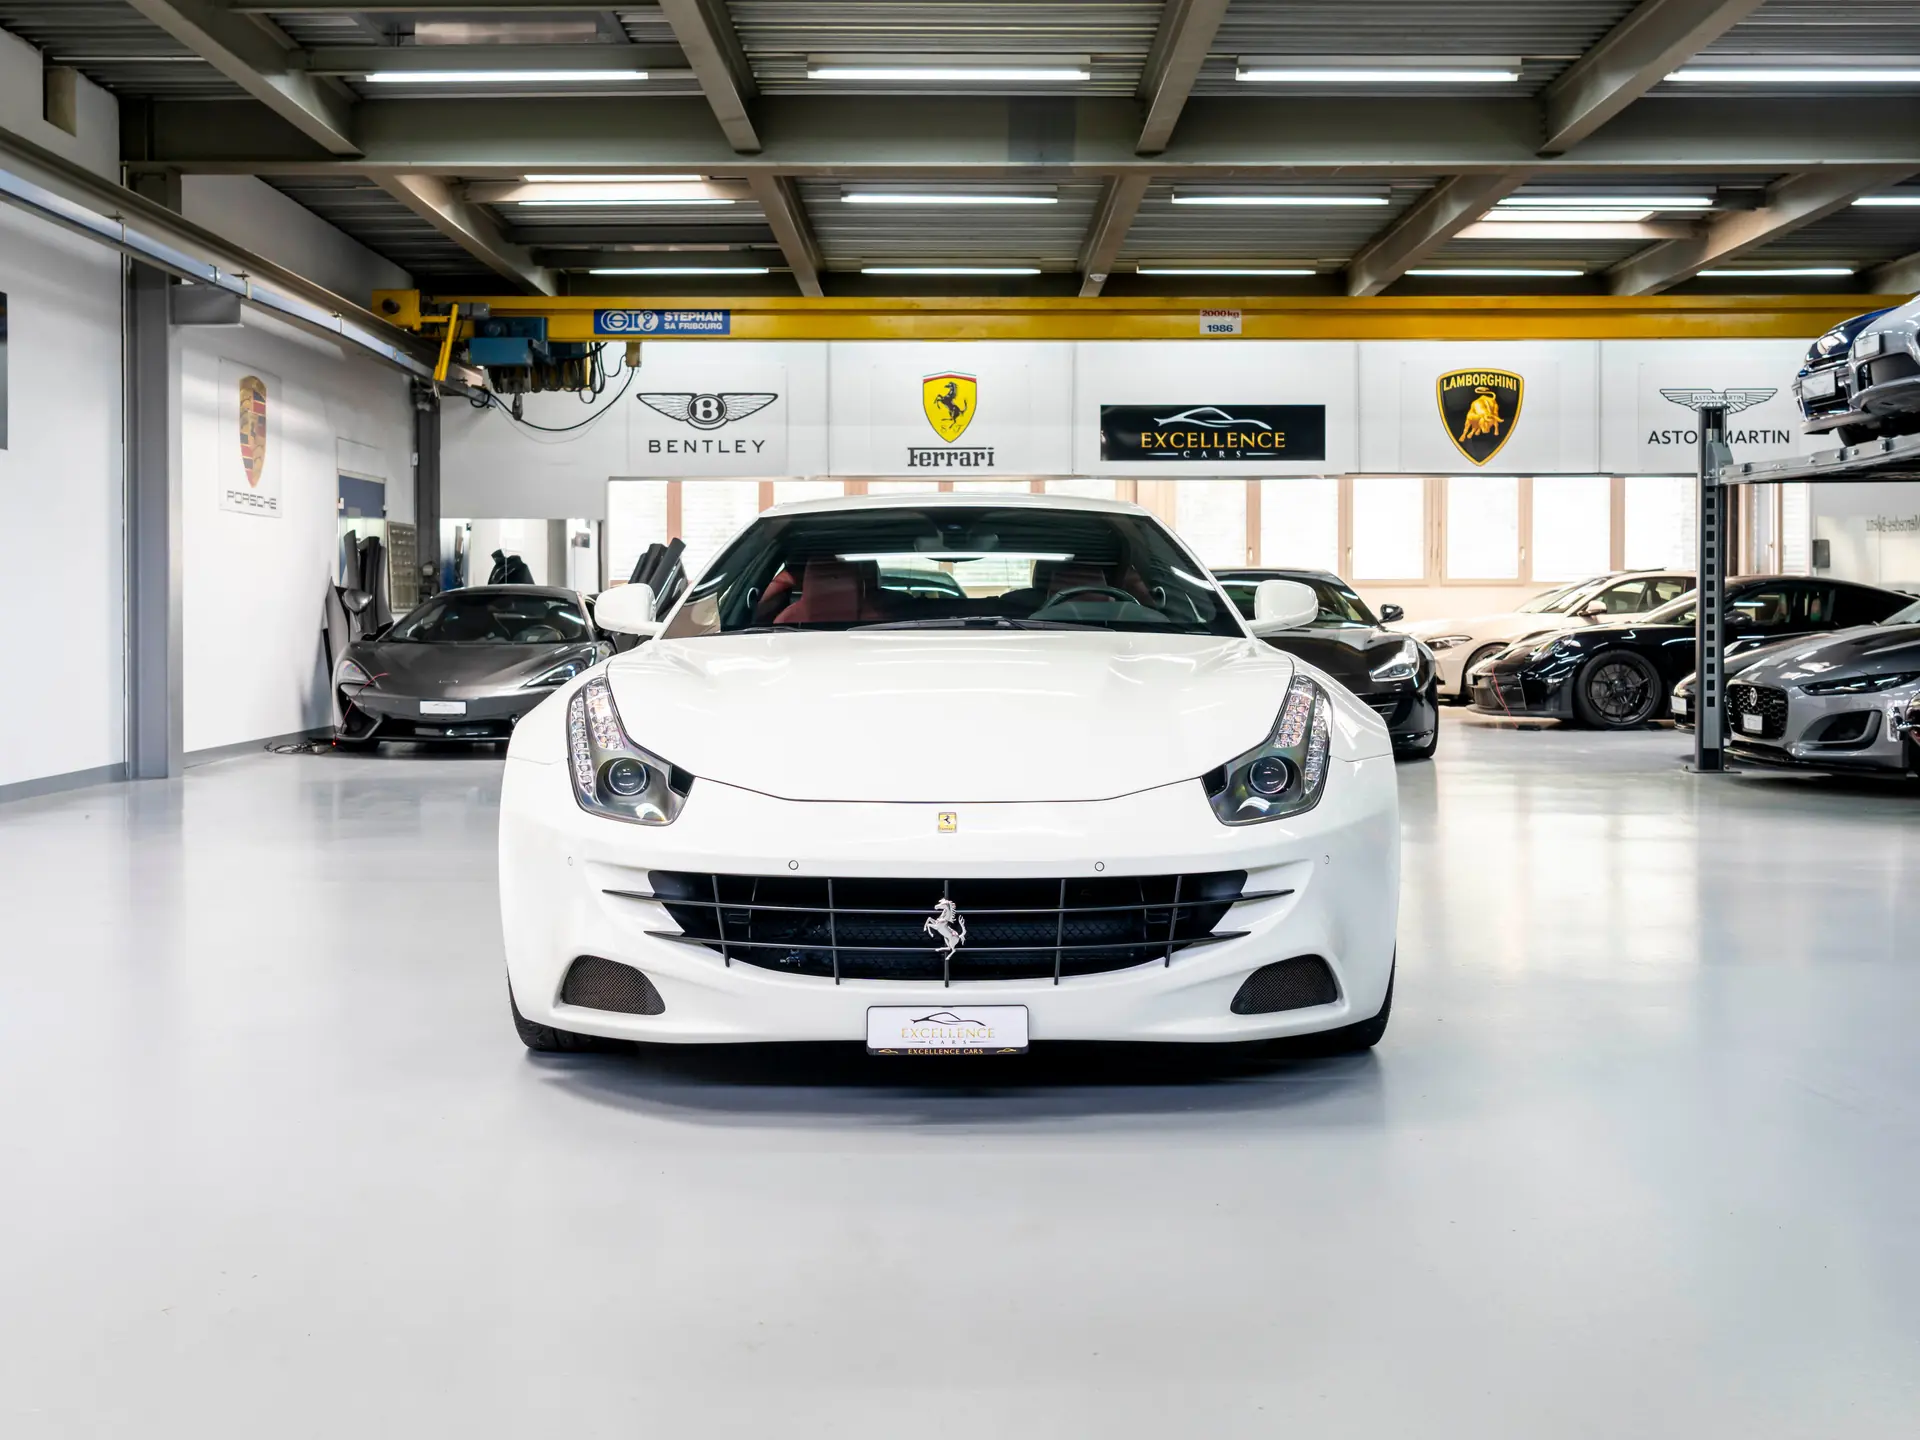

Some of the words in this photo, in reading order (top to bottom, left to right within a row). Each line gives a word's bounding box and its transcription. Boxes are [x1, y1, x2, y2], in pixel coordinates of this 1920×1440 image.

[664, 311, 723, 322] STEPHAN
[664, 322, 676, 330] SA
[678, 322, 723, 330] FRIBOURG
[1207, 324, 1234, 333] 1986
[1443, 373, 1517, 391] LAMBORGHINI
[1141, 432, 1286, 448] EXCELLENCE
[1648, 430, 1699, 444] ASTO
[648, 439, 766, 453] BENTLEY
[907, 447, 995, 467] Ferrari
[1183, 450, 1241, 458] CARS
[227, 490, 277, 509] PORSCHE
[901, 1028, 995, 1038] EXCELLENCE
